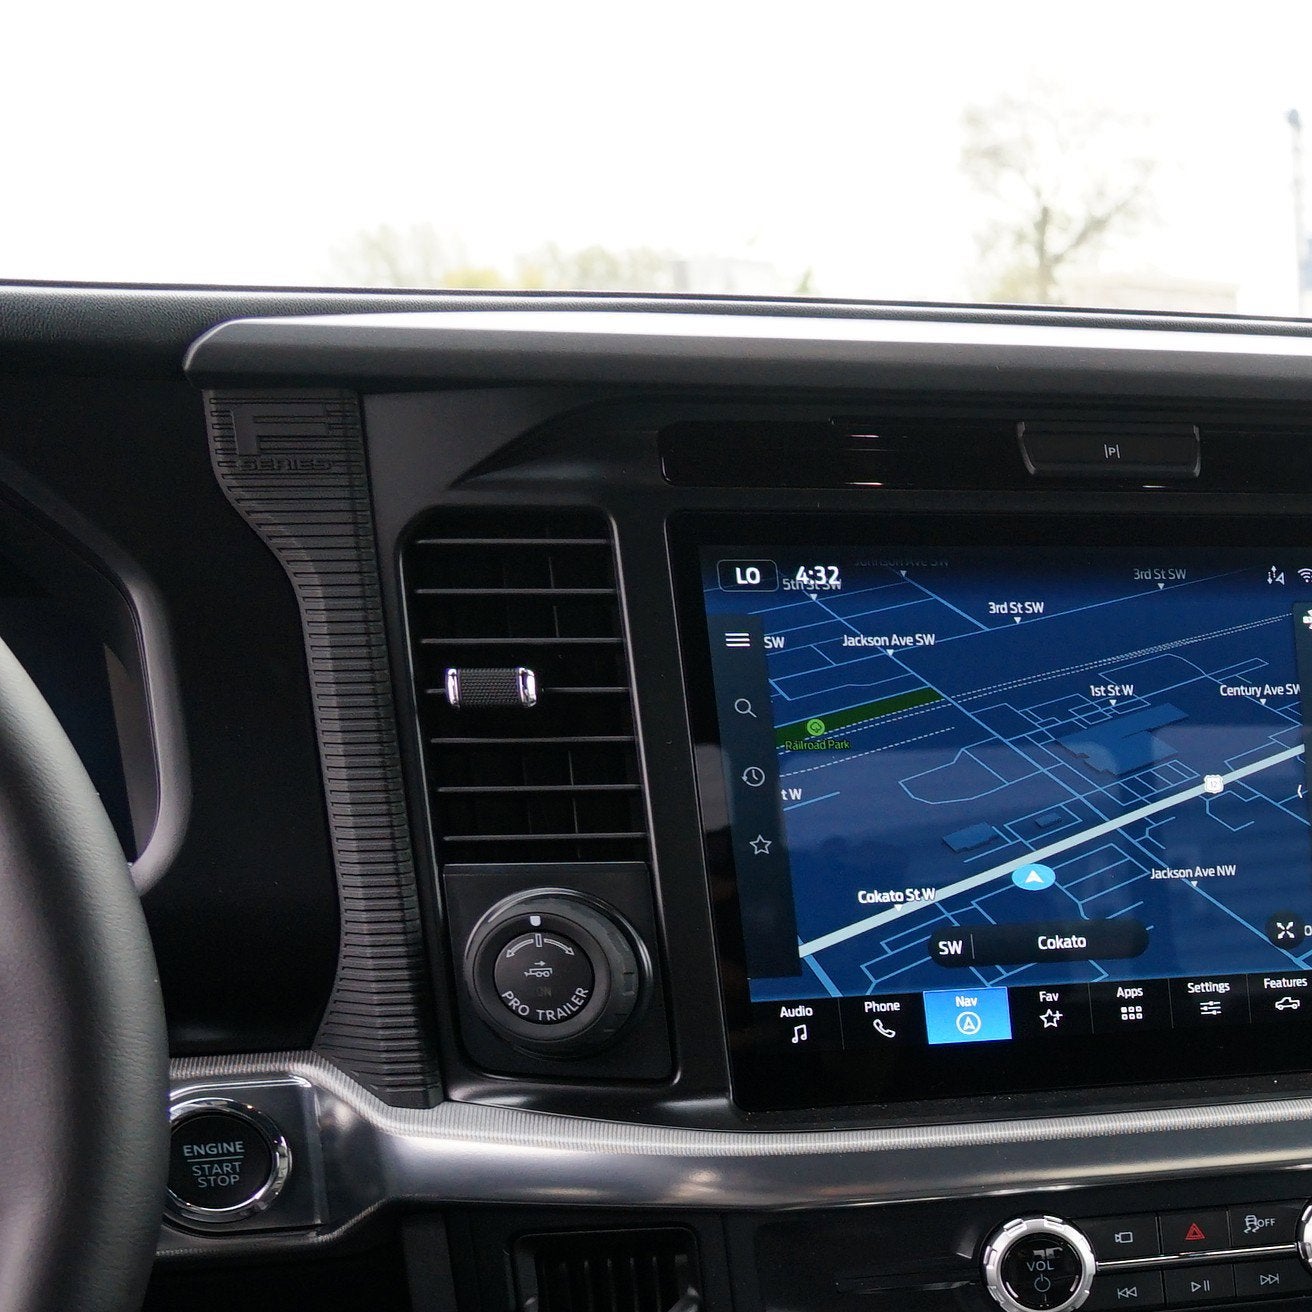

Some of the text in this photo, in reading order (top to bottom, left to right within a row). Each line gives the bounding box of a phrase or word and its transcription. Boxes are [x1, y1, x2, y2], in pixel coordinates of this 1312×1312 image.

[235, 456, 334, 472] SERIES
[735, 566, 761, 585] LO
[795, 565, 840, 585] 4:32
[1133, 567, 1187, 580] 3rd St SW
[988, 600, 1044, 614] 3rd St SW
[763, 636, 785, 649] SW
[842, 633, 935, 648] Jackson Ave SW
[1090, 684, 1134, 696] 1st St W
[1219, 684, 1262, 698] Century
[1263, 684, 1284, 696] Ave
[785, 738, 850, 751] Railroad Park
[788, 788, 802, 800] W
[1150, 864, 1237, 880] Jackson Ave NW
[857, 887, 936, 904] Cokato St W
[938, 940, 963, 955] SW
[1037, 934, 1087, 951] Cokato
[1187, 980, 1230, 994] Settings
[1263, 975, 1308, 989] Features
[1039, 989, 1060, 1002] Fav
[1116, 985, 1144, 1000] Apps
[501, 987, 589, 1022] PRO TRAILER
[864, 999, 901, 1013] Phone
[955, 995, 978, 1008] Nav
[780, 1004, 814, 1018] Audio
[182, 1140, 245, 1157] ENGINE
[191, 1162, 243, 1177] START
[197, 1174, 240, 1188] STOP
[1257, 1216, 1276, 1228] OFF
[1027, 1260, 1055, 1272] VOL
